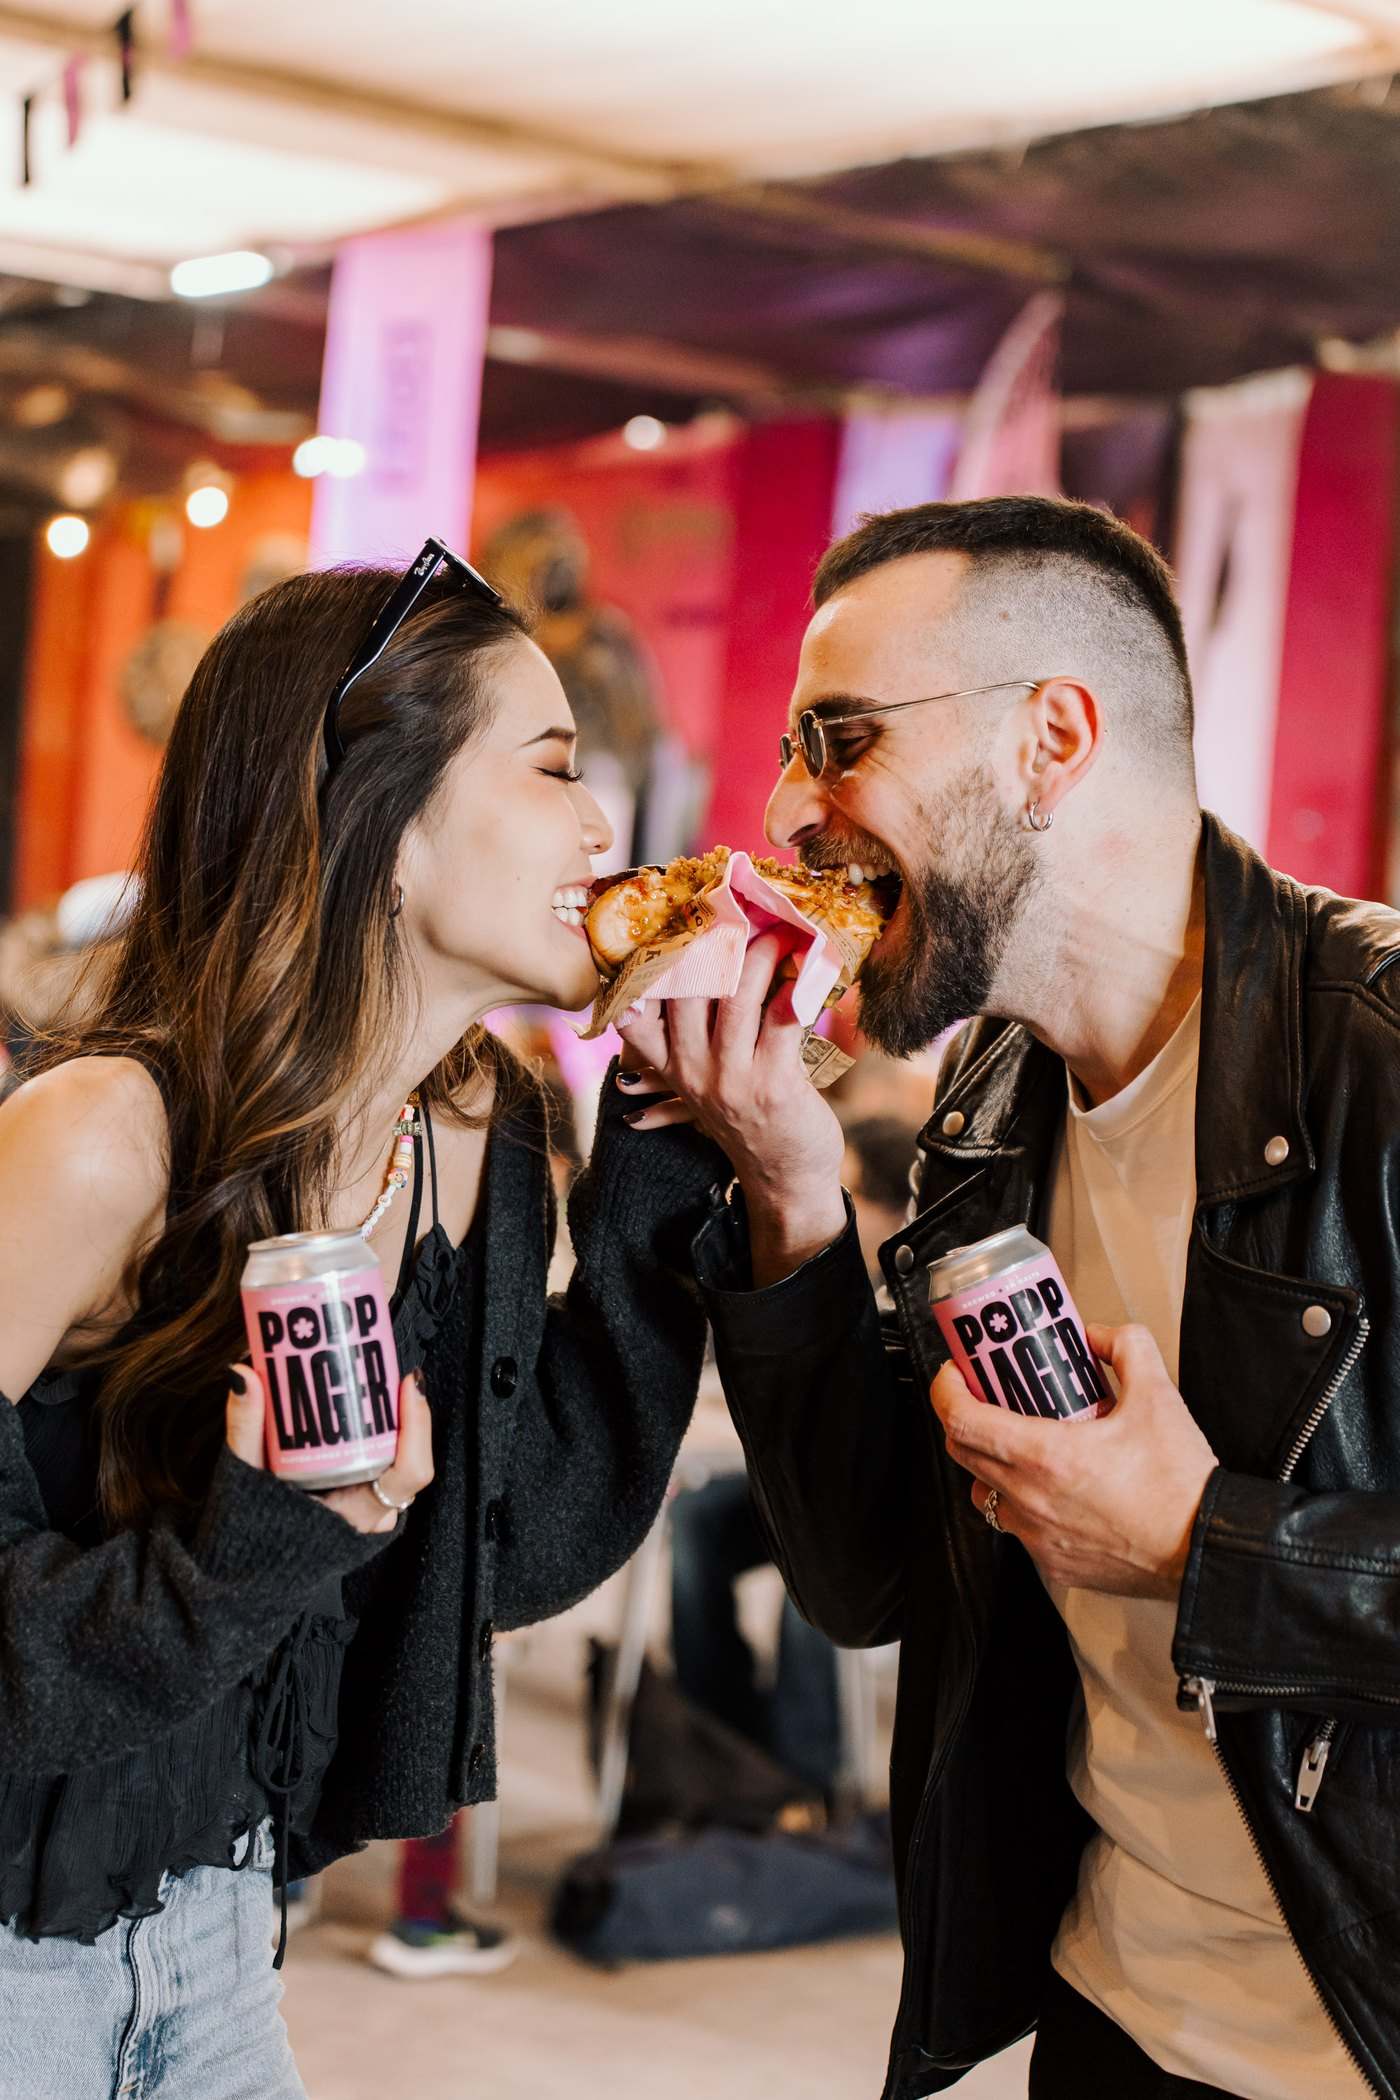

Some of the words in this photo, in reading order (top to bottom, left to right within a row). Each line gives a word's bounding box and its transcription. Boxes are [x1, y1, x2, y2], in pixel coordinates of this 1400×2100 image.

[258, 1295, 377, 1353] POPP
[952, 1277, 1064, 1356] POPP
[265, 1340, 396, 1450] LAGER
